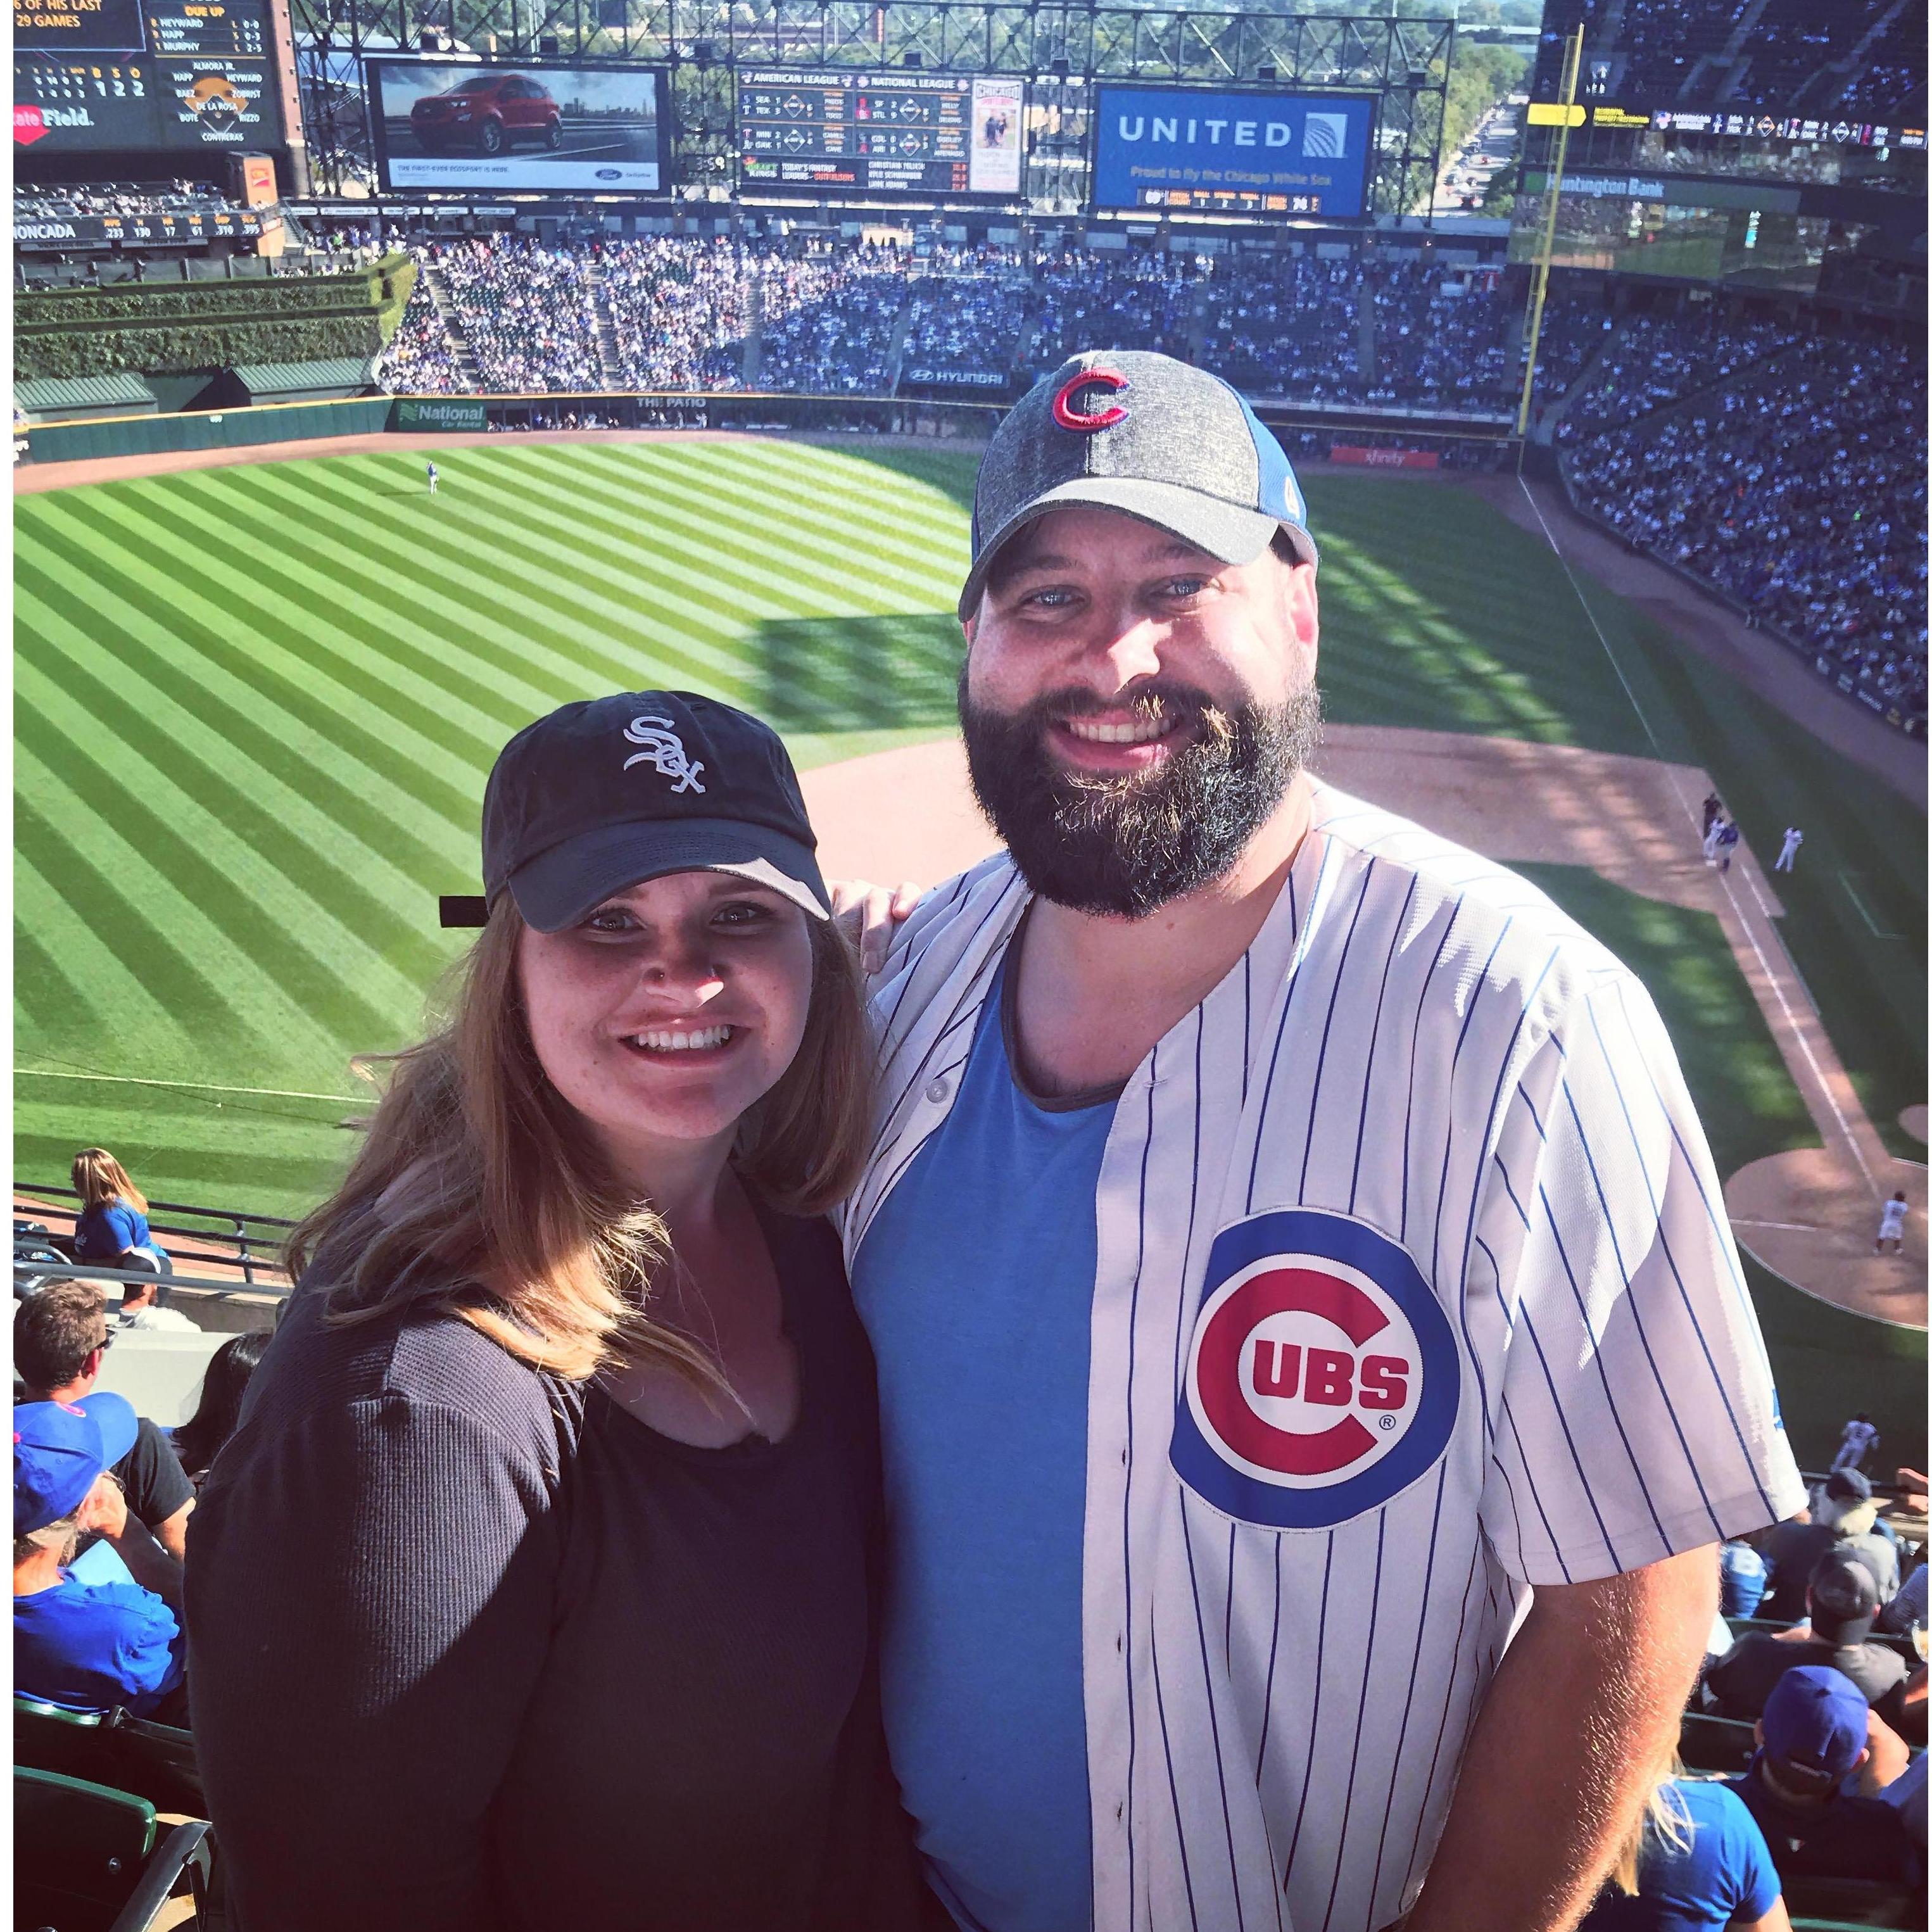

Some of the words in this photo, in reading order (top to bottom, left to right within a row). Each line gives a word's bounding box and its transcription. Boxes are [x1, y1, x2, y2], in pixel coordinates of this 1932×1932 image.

[25, 0, 42, 10] OF
[47, 0, 68, 10] HIS
[71, 0, 101, 11] LAST
[184, 5, 208, 16] DUE
[209, 5, 225, 16] UP
[16, 15, 31, 27] 29
[34, 15, 81, 27] GAMES
[160, 18, 203, 28] HEYWARD
[161, 30, 184, 39] HAPP
[163, 41, 199, 51] MURPHY
[173, 72, 193, 81] HAPP
[225, 73, 262, 82] HEYWARD
[754, 73, 802, 84] AMERICAN
[804, 75, 840, 85] LEAGUE
[871, 77, 918, 87] NATIONAL
[919, 79, 956, 89] LEAGUE
[96, 81, 106, 96] 1
[113, 80, 126, 96] 2
[132, 80, 144, 96] 2
[239, 114, 260, 123] RIZZO
[201, 132, 244, 142] CONTRERAS
[1119, 117, 1291, 147] UNITED
[781, 163, 809, 172] TODAY'S
[1131, 166, 1166, 179] Proud
[1169, 169, 1181, 179] to
[1184, 168, 1200, 182] fly
[1203, 169, 1222, 181] the
[1225, 170, 1270, 184] Chicago
[1272, 172, 1308, 184] White
[1311, 174, 1331, 185] Sox
[1629, 178, 1664, 197] Bank
[106, 228, 124, 239] .233
[134, 227, 151, 237] 130
[165, 227, 175, 236] 17
[937, 371, 1003, 384] HYUNDAI
[667, 398, 706, 407] PATIO
[1052, 367, 1130, 432] C
[419, 405, 484, 420] National
[1365, 450, 1406, 467] xfinity
[623, 716, 705, 793] Sox
